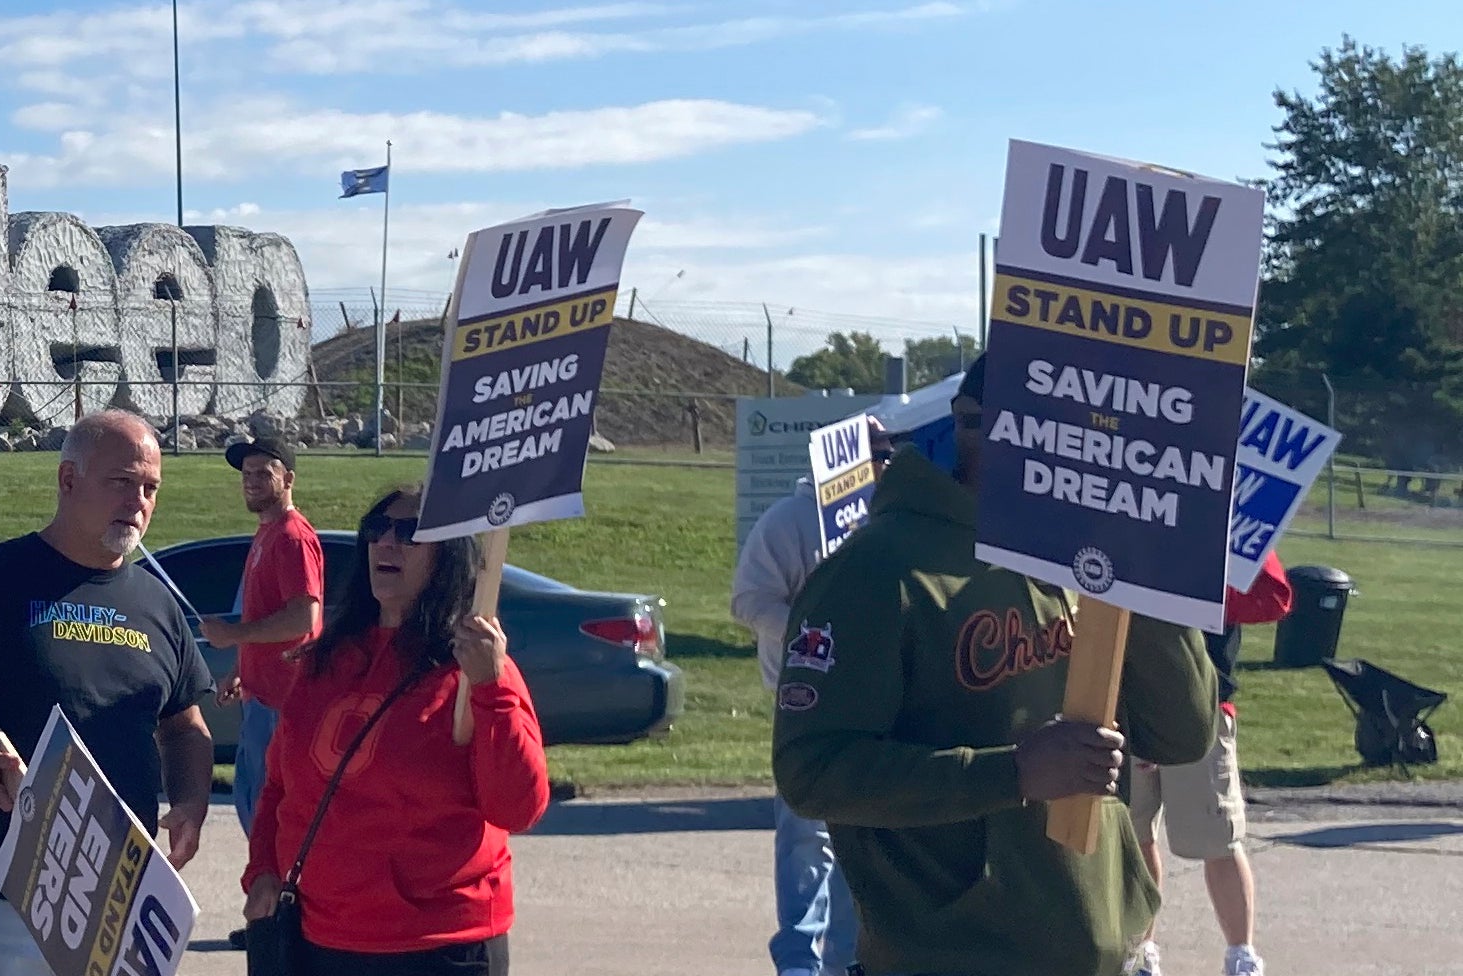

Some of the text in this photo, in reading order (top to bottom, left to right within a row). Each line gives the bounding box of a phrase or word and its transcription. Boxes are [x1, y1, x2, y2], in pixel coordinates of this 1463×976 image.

[1040, 163, 1223, 287] UAW
[491, 217, 613, 300] UAW
[463, 298, 608, 353] STAND UP
[1005, 284, 1234, 352] STAND UP
[472, 354, 580, 404] SAVING
[1024, 359, 1194, 424] SAVING
[441, 390, 594, 453] AMERICAN
[460, 428, 563, 479] DREAM
[821, 421, 860, 471] UAW
[988, 409, 1226, 491] AMERICAN
[1089, 411, 1120, 432] THE
[824, 467, 870, 500] STAND UP
[834, 497, 869, 529] COLA
[1022, 458, 1179, 528] DREAM
[53, 620, 152, 653] DAVIDSON
[30, 768, 96, 942] TIERS
[60, 814, 111, 950] END
[99, 838, 141, 956] STAND
